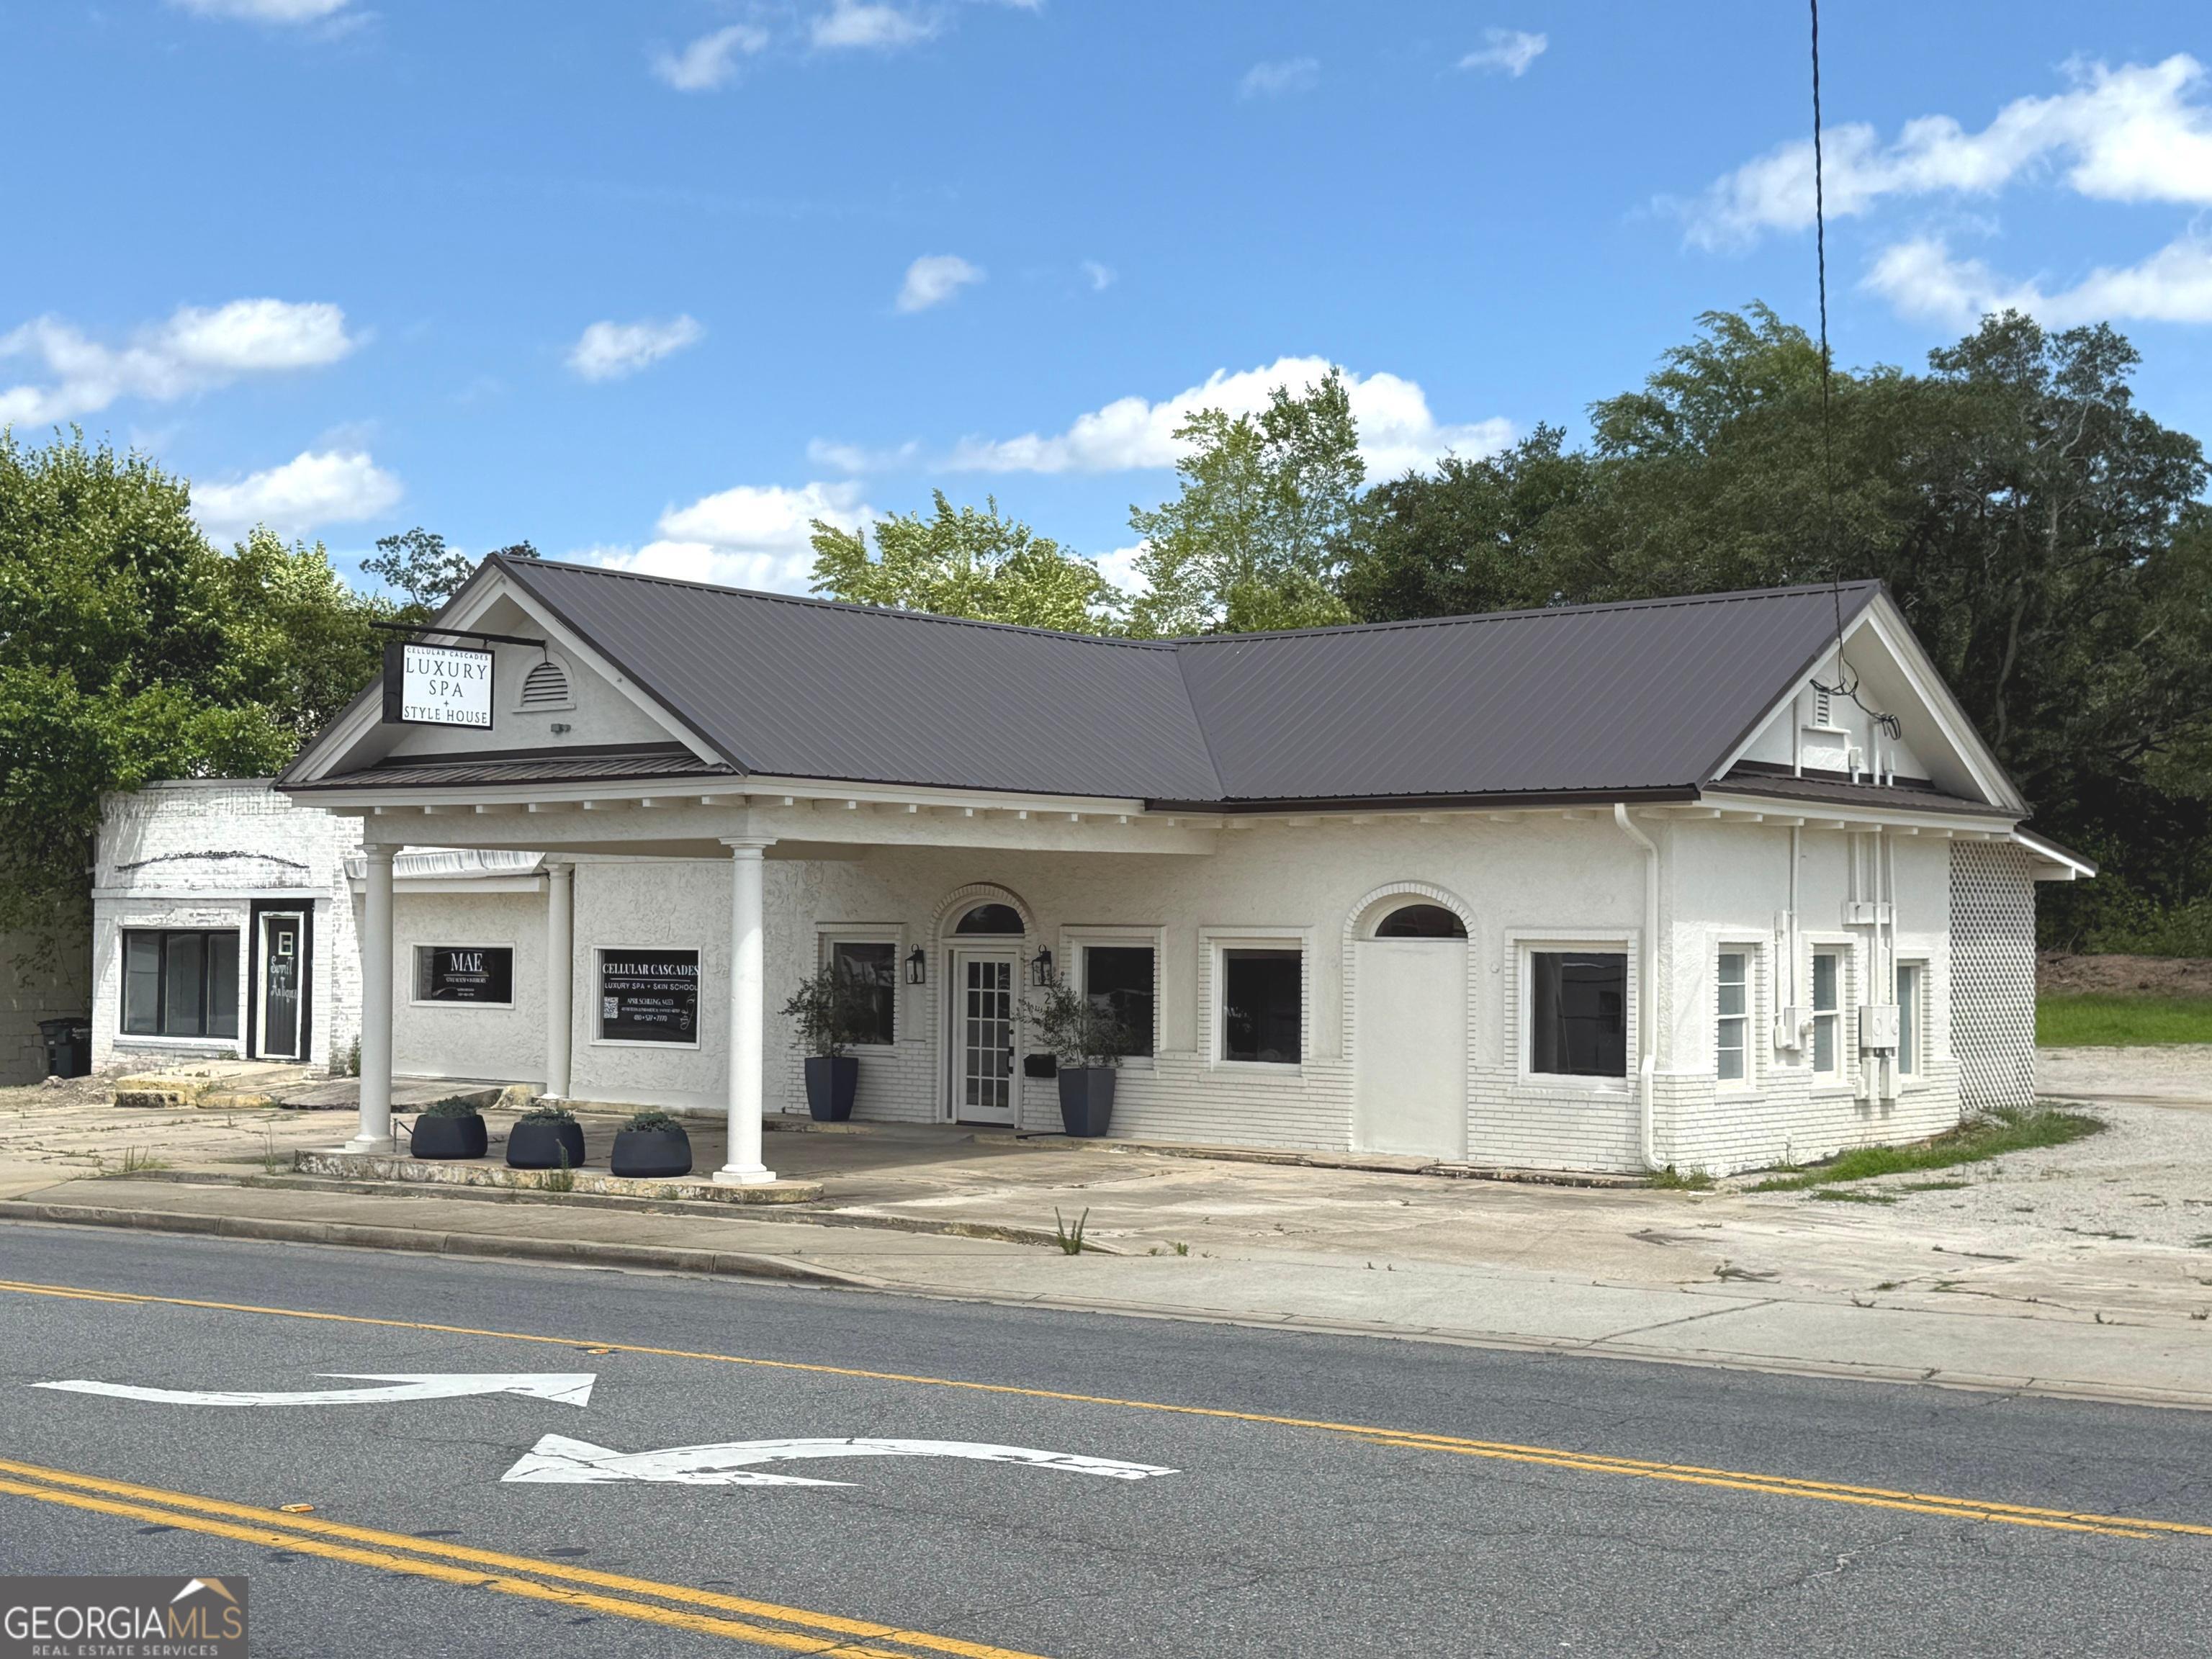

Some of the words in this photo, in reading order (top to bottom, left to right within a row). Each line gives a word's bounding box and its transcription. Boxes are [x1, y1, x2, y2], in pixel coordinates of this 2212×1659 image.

[407, 647, 446, 656] CELLULAR
[449, 651, 488, 661] CASCADES
[405, 657, 487, 680] LUXURY
[429, 679, 463, 697] SPA
[404, 706, 441, 720] STYLE
[447, 709, 487, 724] HOUSE
[451, 953, 483, 971] MAE
[602, 963, 649, 975] CELLULAR
[651, 964, 698, 976] CASCADES
